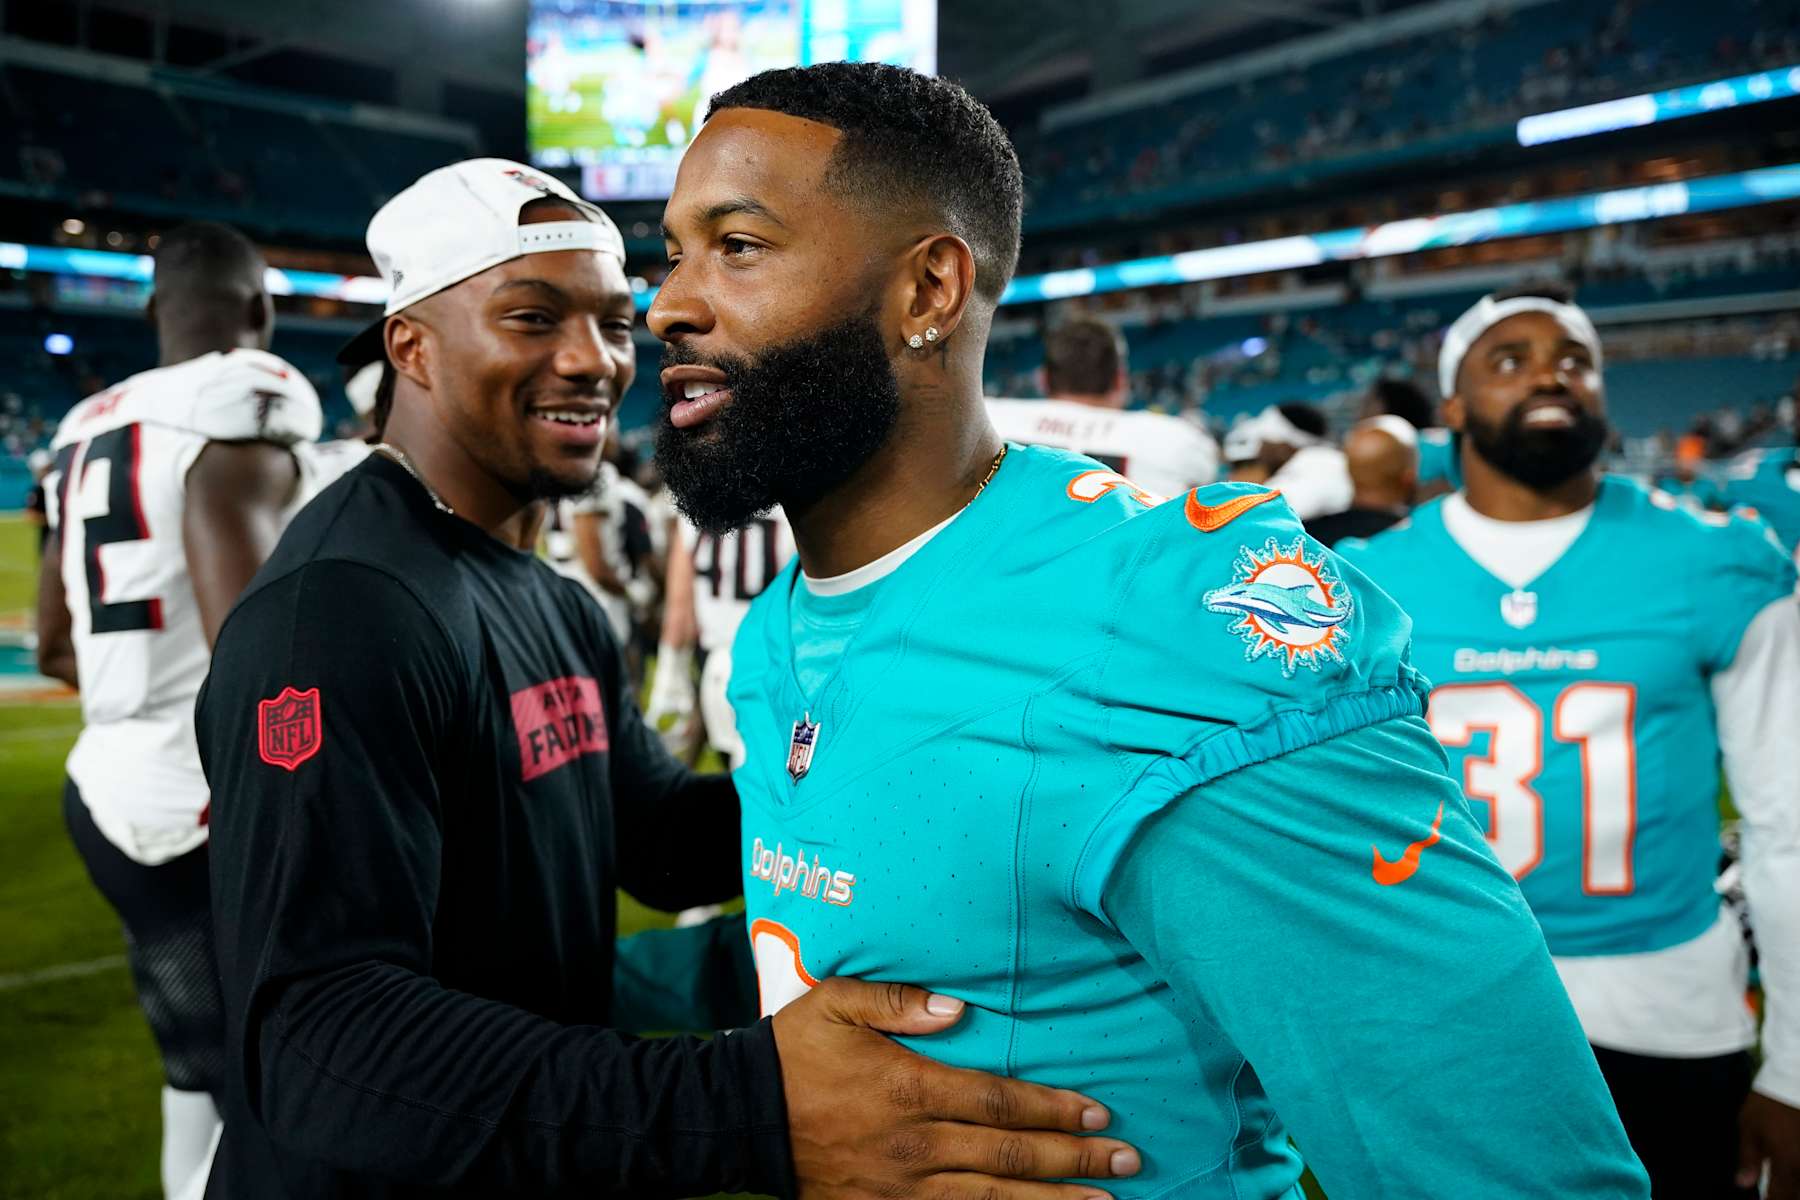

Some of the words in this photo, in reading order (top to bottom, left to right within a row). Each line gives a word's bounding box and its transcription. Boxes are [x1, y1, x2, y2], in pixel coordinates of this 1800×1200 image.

[270, 717, 314, 754] NFL
[1427, 679, 1637, 896] 31
[750, 836, 857, 907] Dolphins
